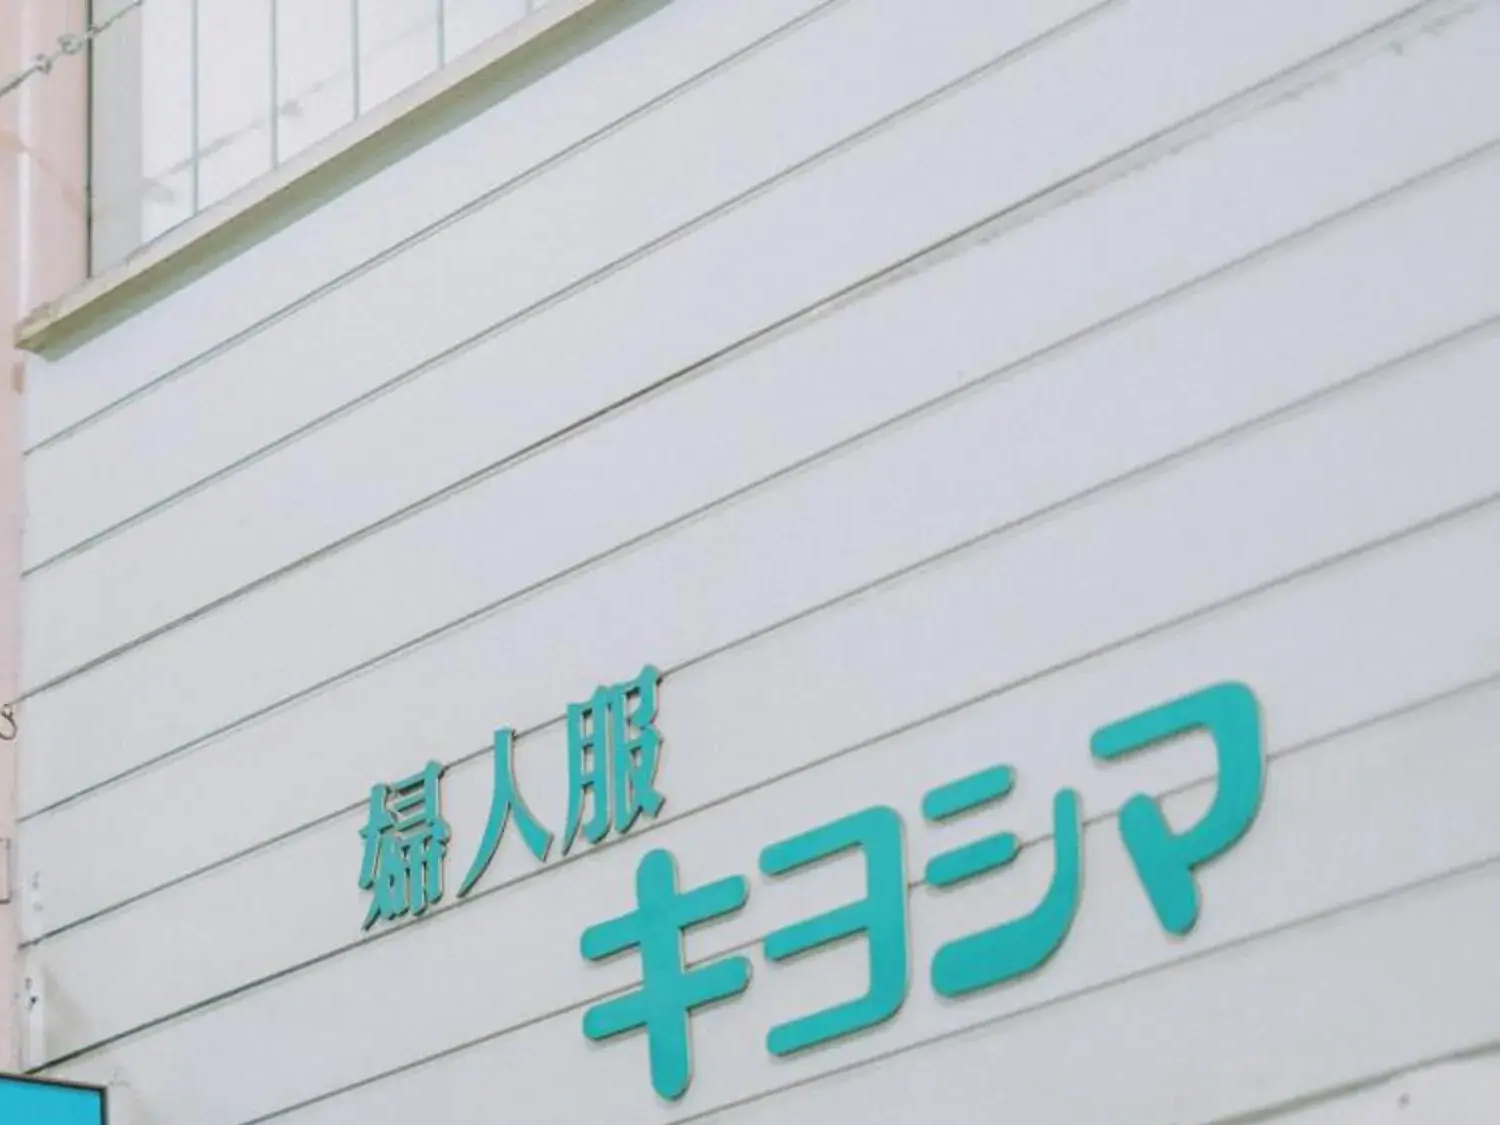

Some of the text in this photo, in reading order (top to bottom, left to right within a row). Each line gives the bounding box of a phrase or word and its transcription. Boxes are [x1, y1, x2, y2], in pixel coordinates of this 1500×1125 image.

[361, 664, 666, 932] 婦人服
[580, 681, 1269, 1101] キヨシマ
